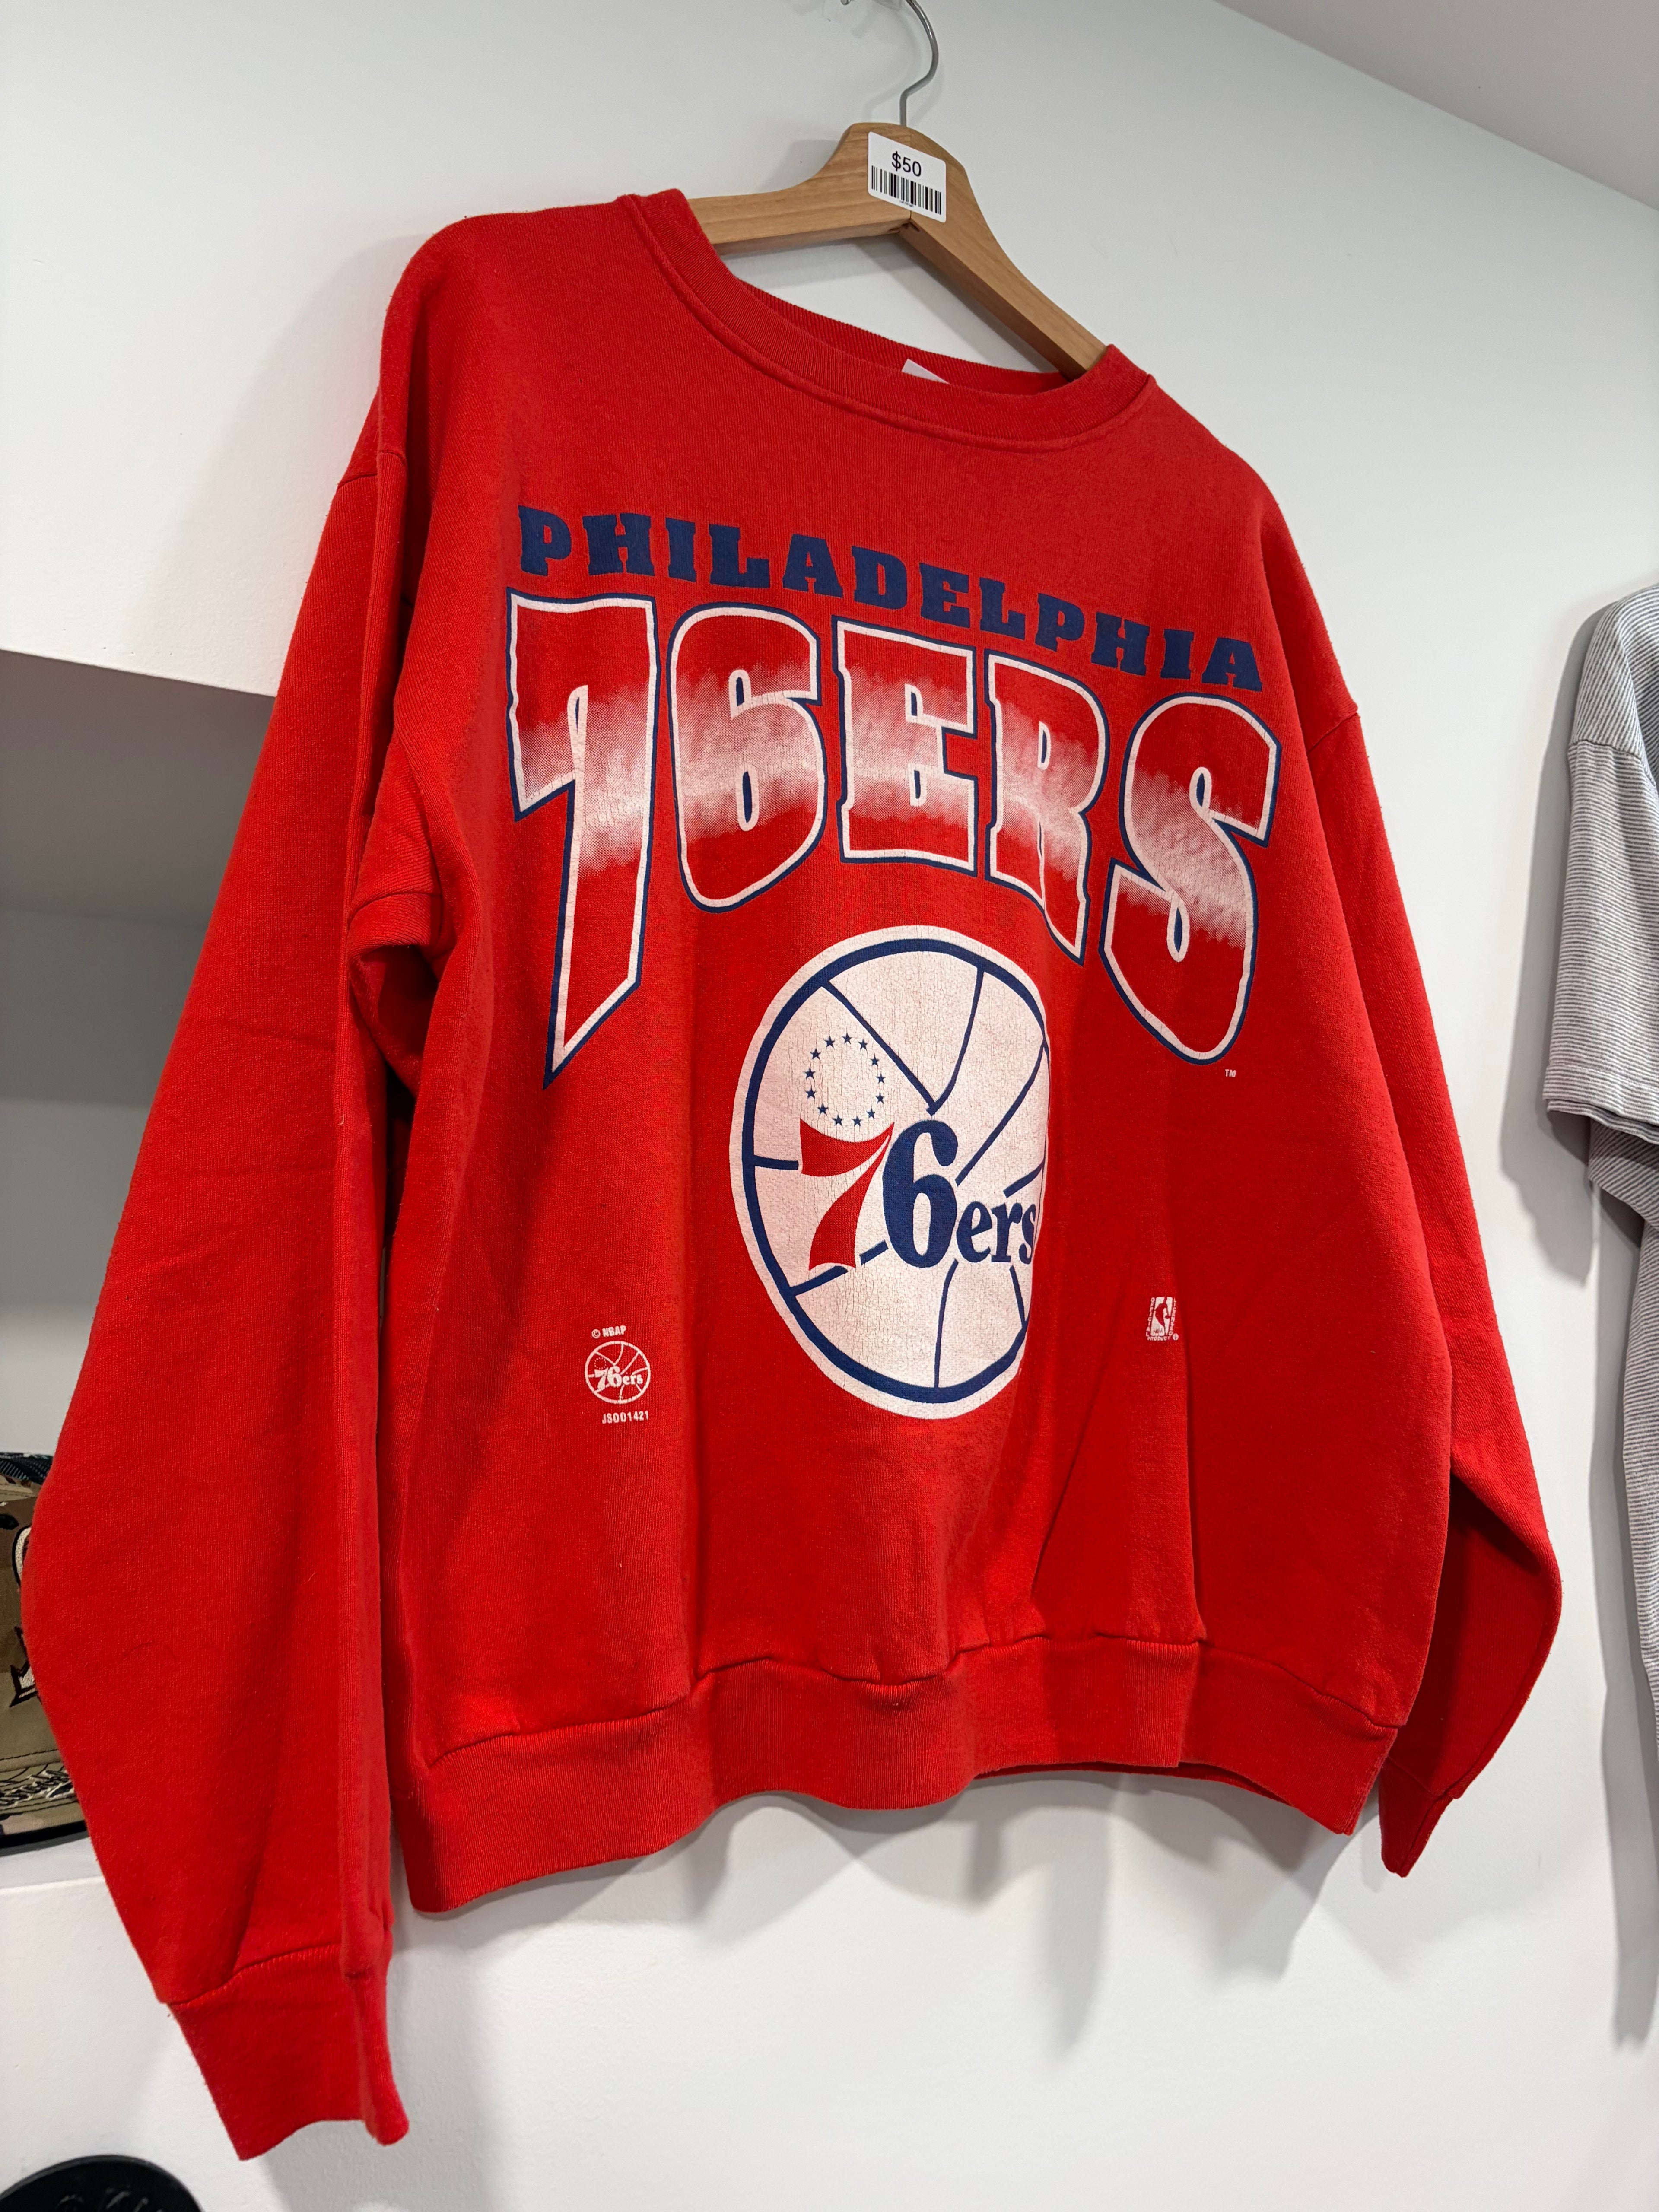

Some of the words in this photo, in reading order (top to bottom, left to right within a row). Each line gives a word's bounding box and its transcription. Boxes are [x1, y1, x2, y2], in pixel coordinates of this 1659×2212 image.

[891, 151, 922, 177] $50
[518, 505, 1263, 692] PHILADELPHIA
[506, 588, 1282, 1090] 76ERS
[1225, 1069, 1236, 1077] TM
[800, 1118, 1037, 1271] 76ers
[594, 1366, 643, 1390] 76ers
